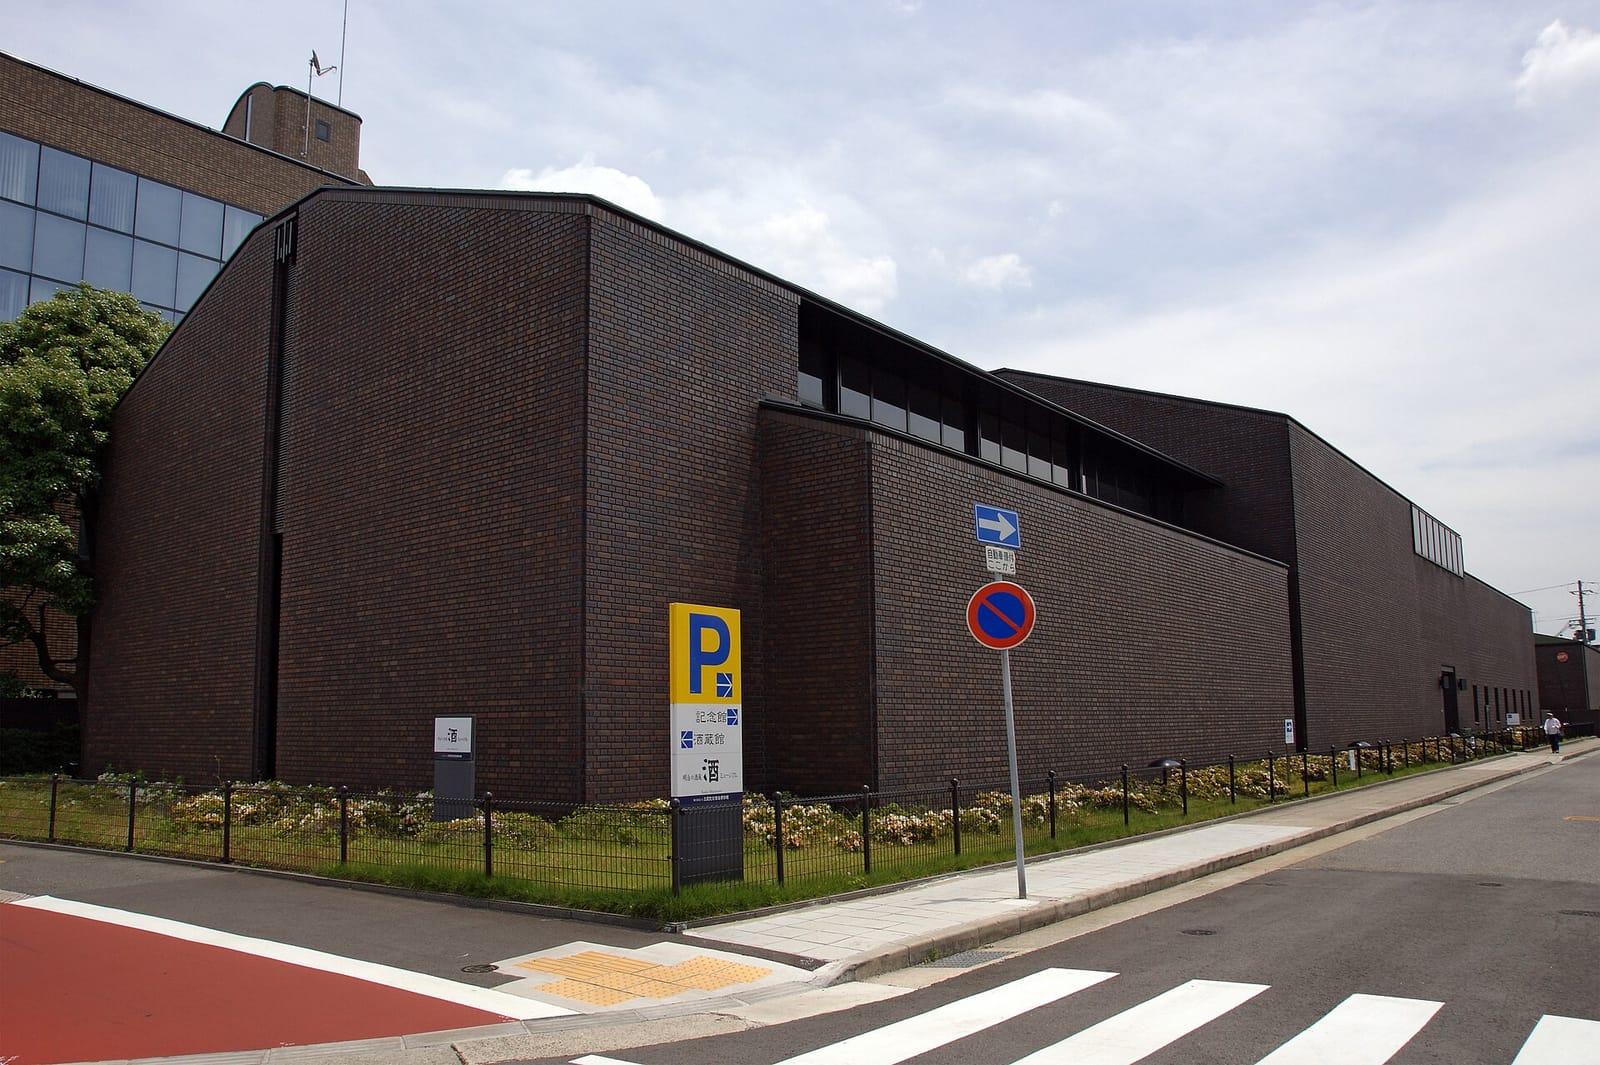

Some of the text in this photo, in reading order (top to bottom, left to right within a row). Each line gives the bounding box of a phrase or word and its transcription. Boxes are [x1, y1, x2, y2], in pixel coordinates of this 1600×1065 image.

[690, 613, 731, 694] P
[696, 711, 727, 723] 記念館
[447, 728, 458, 743] 酒
[694, 733, 725, 745] 酒蔵館
[702, 758, 719, 783] 酒
